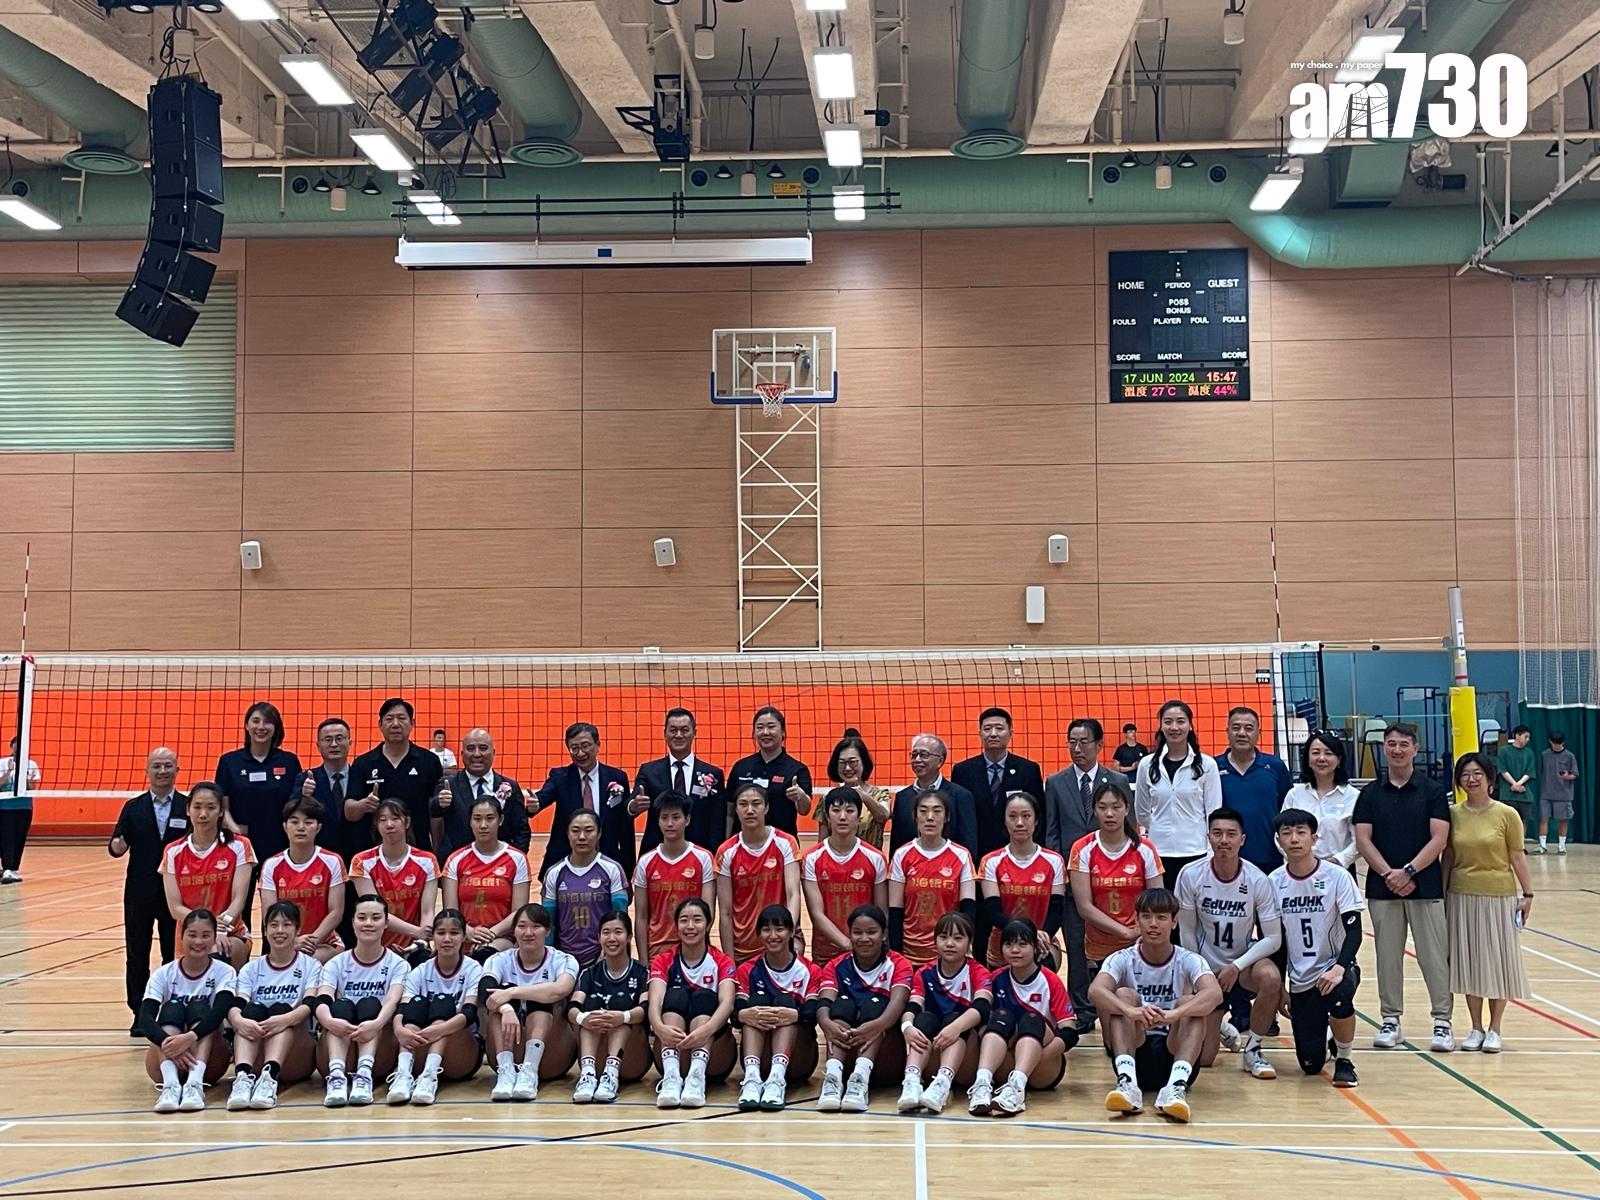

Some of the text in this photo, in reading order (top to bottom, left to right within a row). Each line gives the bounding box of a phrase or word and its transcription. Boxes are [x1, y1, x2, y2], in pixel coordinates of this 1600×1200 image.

[1118, 281, 1145, 290] HOME
[1208, 279, 1239, 288] GUEST
[1168, 298, 1189, 306] POSS
[1113, 318, 1136, 326] FOULS
[1153, 317, 1181, 325] PLAYER
[1222, 315, 1247, 323] FOULS
[1222, 351, 1247, 359] SCORE
[1124, 372, 1237, 383] 17 JUN 2024 15:47
[1213, 385, 1237, 395] 44%
[1201, 897, 1247, 912] EdUHK
[1281, 895, 1325, 909] EdUHK
[1201, 907, 1247, 918] VOLLEYBALL
[1213, 921, 1233, 949] 14
[1300, 918, 1313, 949] 5
[257, 985, 299, 995] EdUHK
[345, 980, 386, 991] EdUHK
[1137, 984, 1175, 997] EdUH
